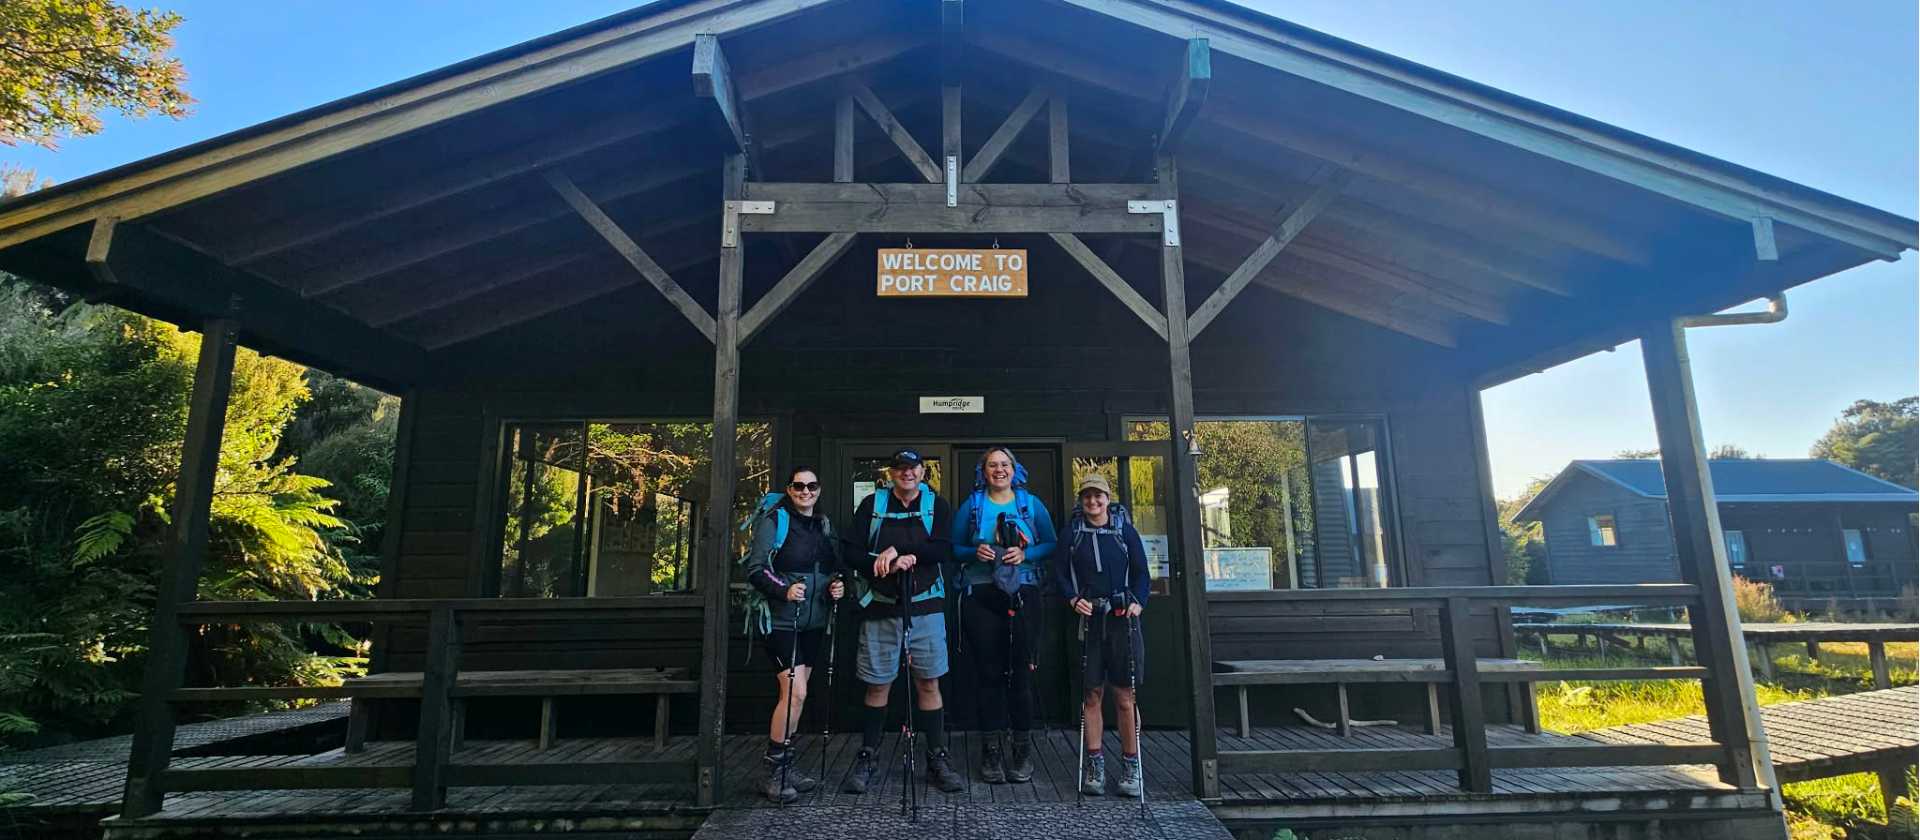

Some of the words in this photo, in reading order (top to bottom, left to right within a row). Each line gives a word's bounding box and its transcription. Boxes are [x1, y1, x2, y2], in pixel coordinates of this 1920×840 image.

[881, 253, 983, 271] WELCOME
[994, 254, 1023, 271] TO
[880, 274, 938, 292] PORT
[949, 274, 1023, 292] CRAIG.
